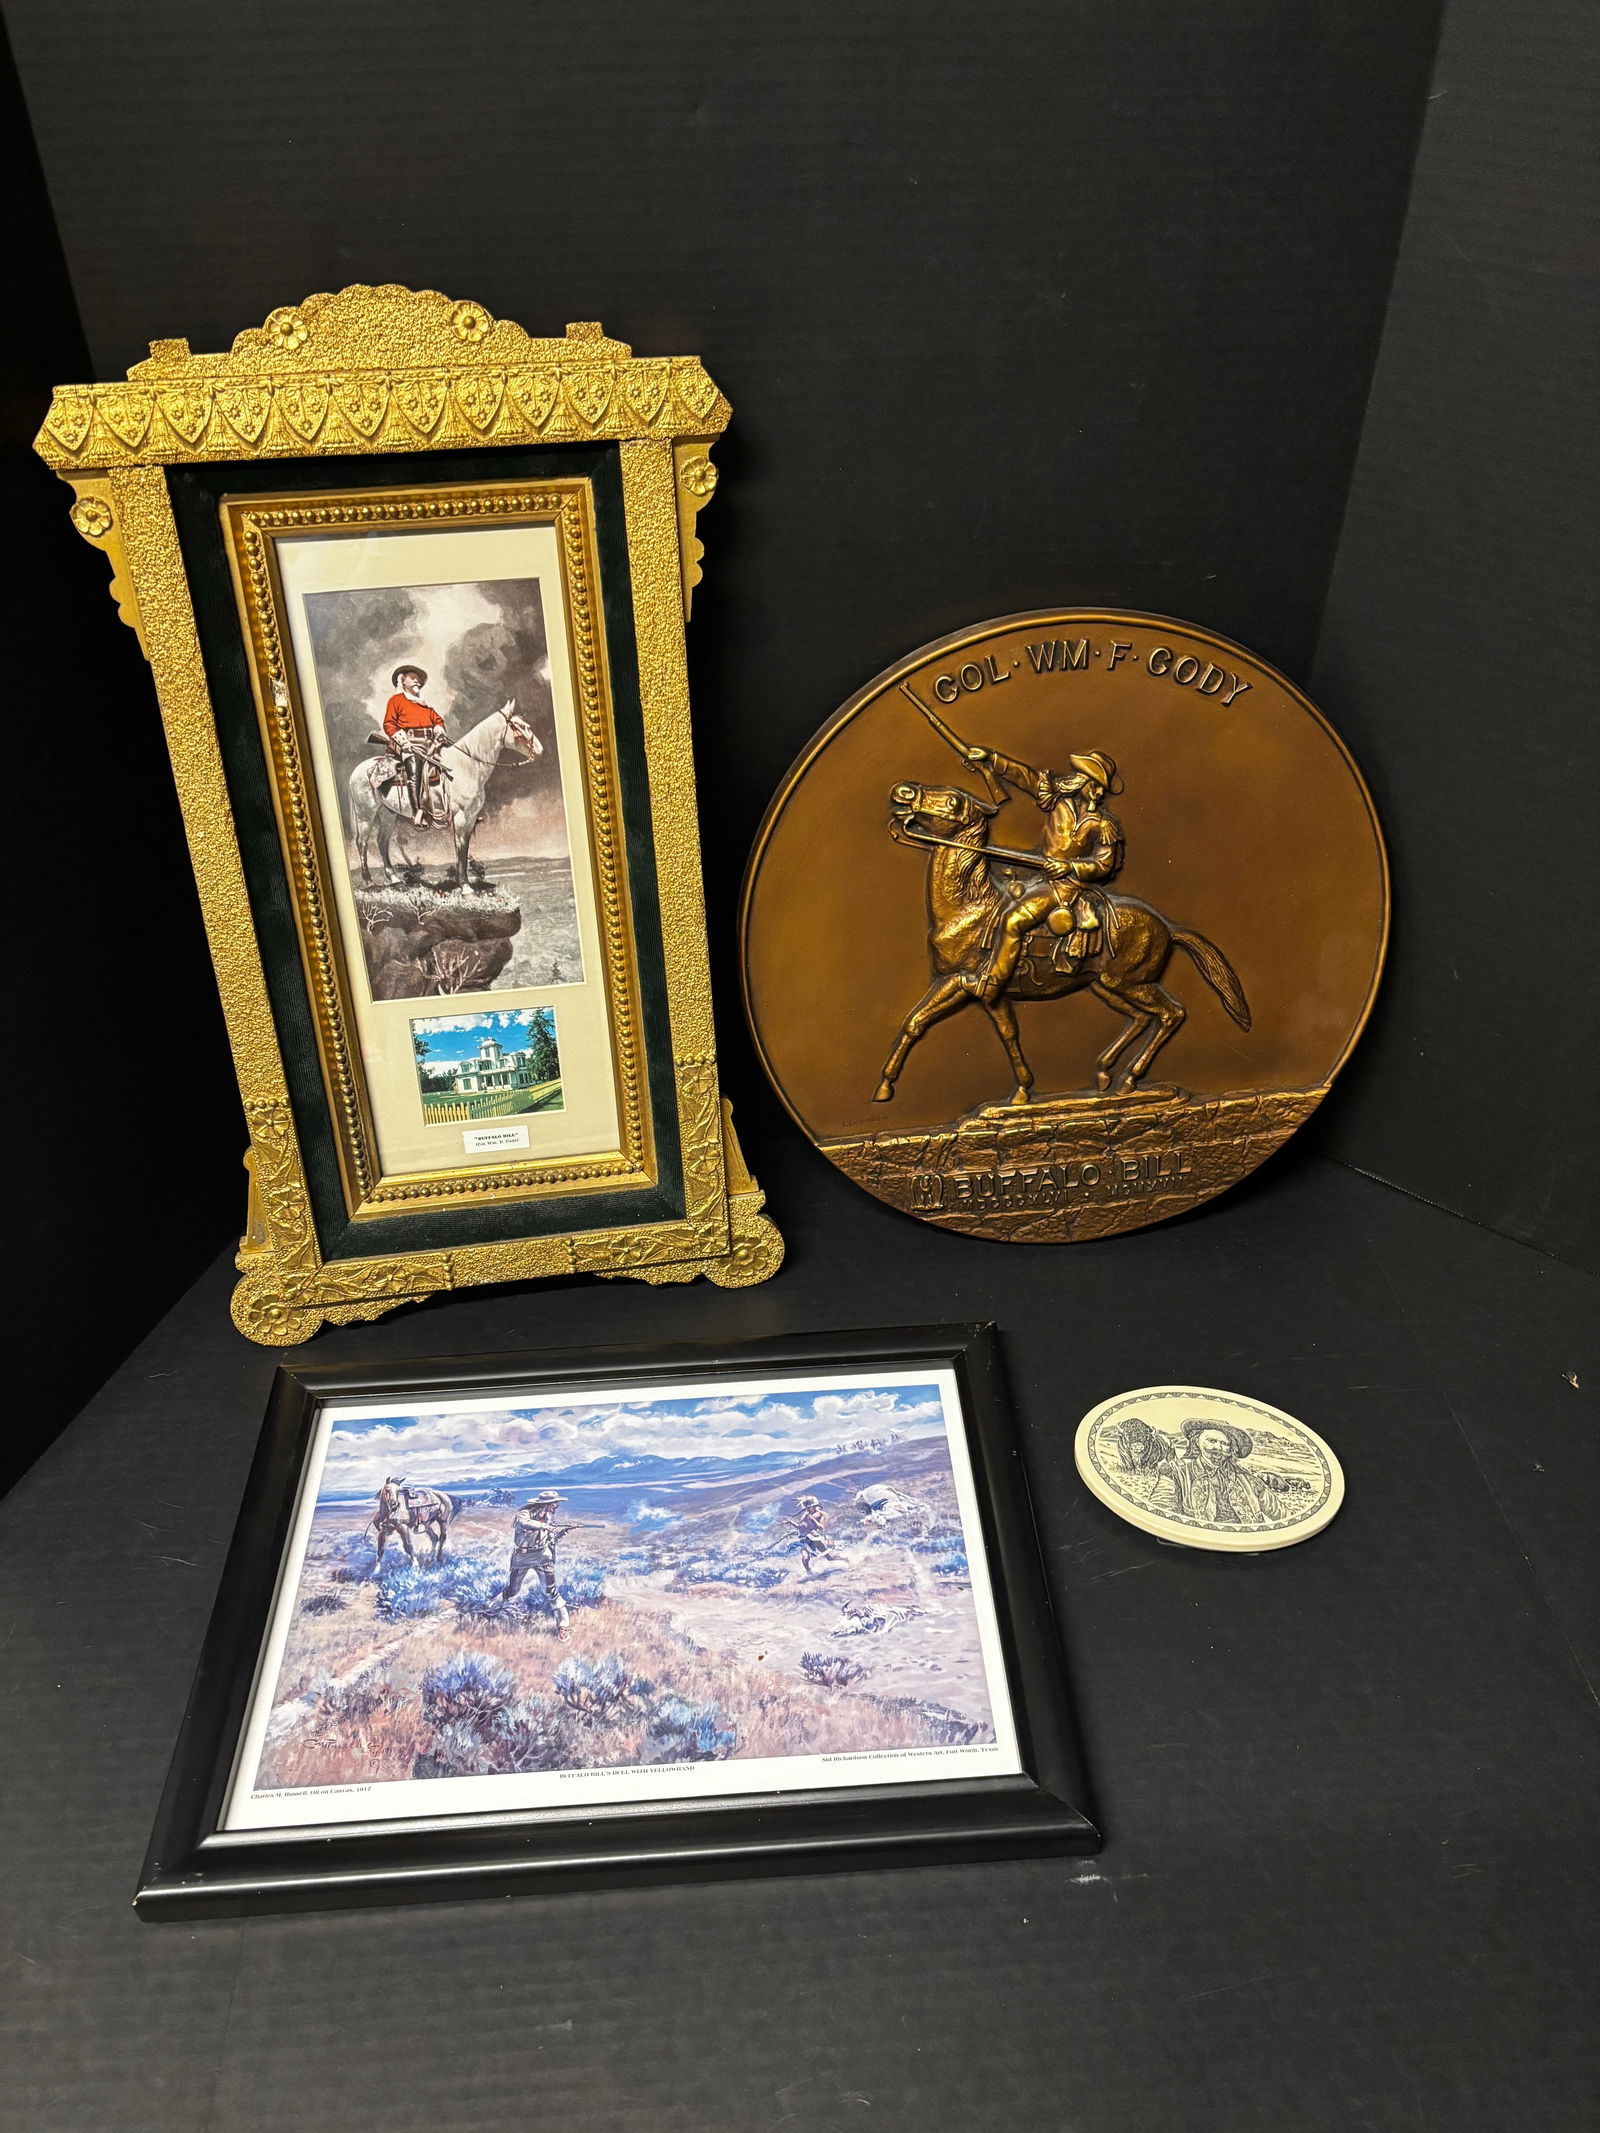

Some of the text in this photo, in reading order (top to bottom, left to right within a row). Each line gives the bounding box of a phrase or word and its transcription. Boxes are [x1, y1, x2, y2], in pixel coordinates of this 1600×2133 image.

[1147, 647, 1251, 706] CODY
[953, 1152, 1193, 1199] BUFFALO BILL
